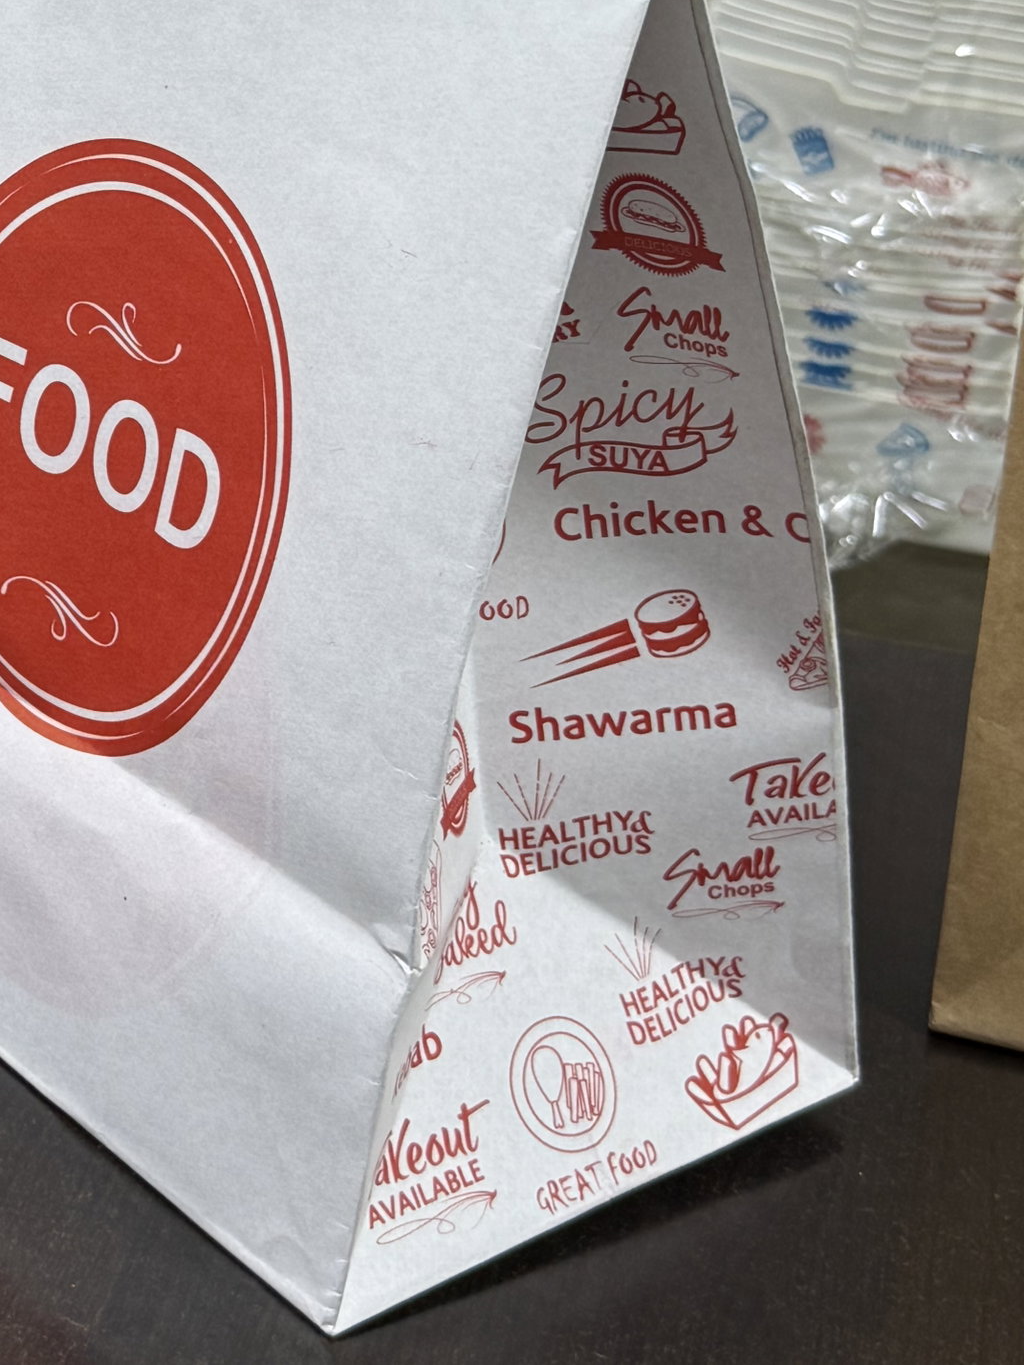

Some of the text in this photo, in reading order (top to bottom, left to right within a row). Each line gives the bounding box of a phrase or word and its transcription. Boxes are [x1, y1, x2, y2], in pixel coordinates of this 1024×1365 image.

[617, 286, 730, 352] Small
[663, 333, 729, 357] Chops
[525, 373, 705, 460] Spicy
[587, 443, 670, 472] SUYA
[554, 500, 726, 541] Chicken
[741, 505, 774, 538] &
[509, 702, 737, 744] Shawarma
[729, 752, 836, 805] Take
[499, 834, 652, 879] DELICIOUS
[663, 846, 781, 911] Small
[708, 881, 775, 900] Chops
[627, 979, 743, 1046] DELICIOUS
[369, 1159, 485, 1230] AVAILABLE
[536, 1139, 658, 1215] GREAT FOOD
